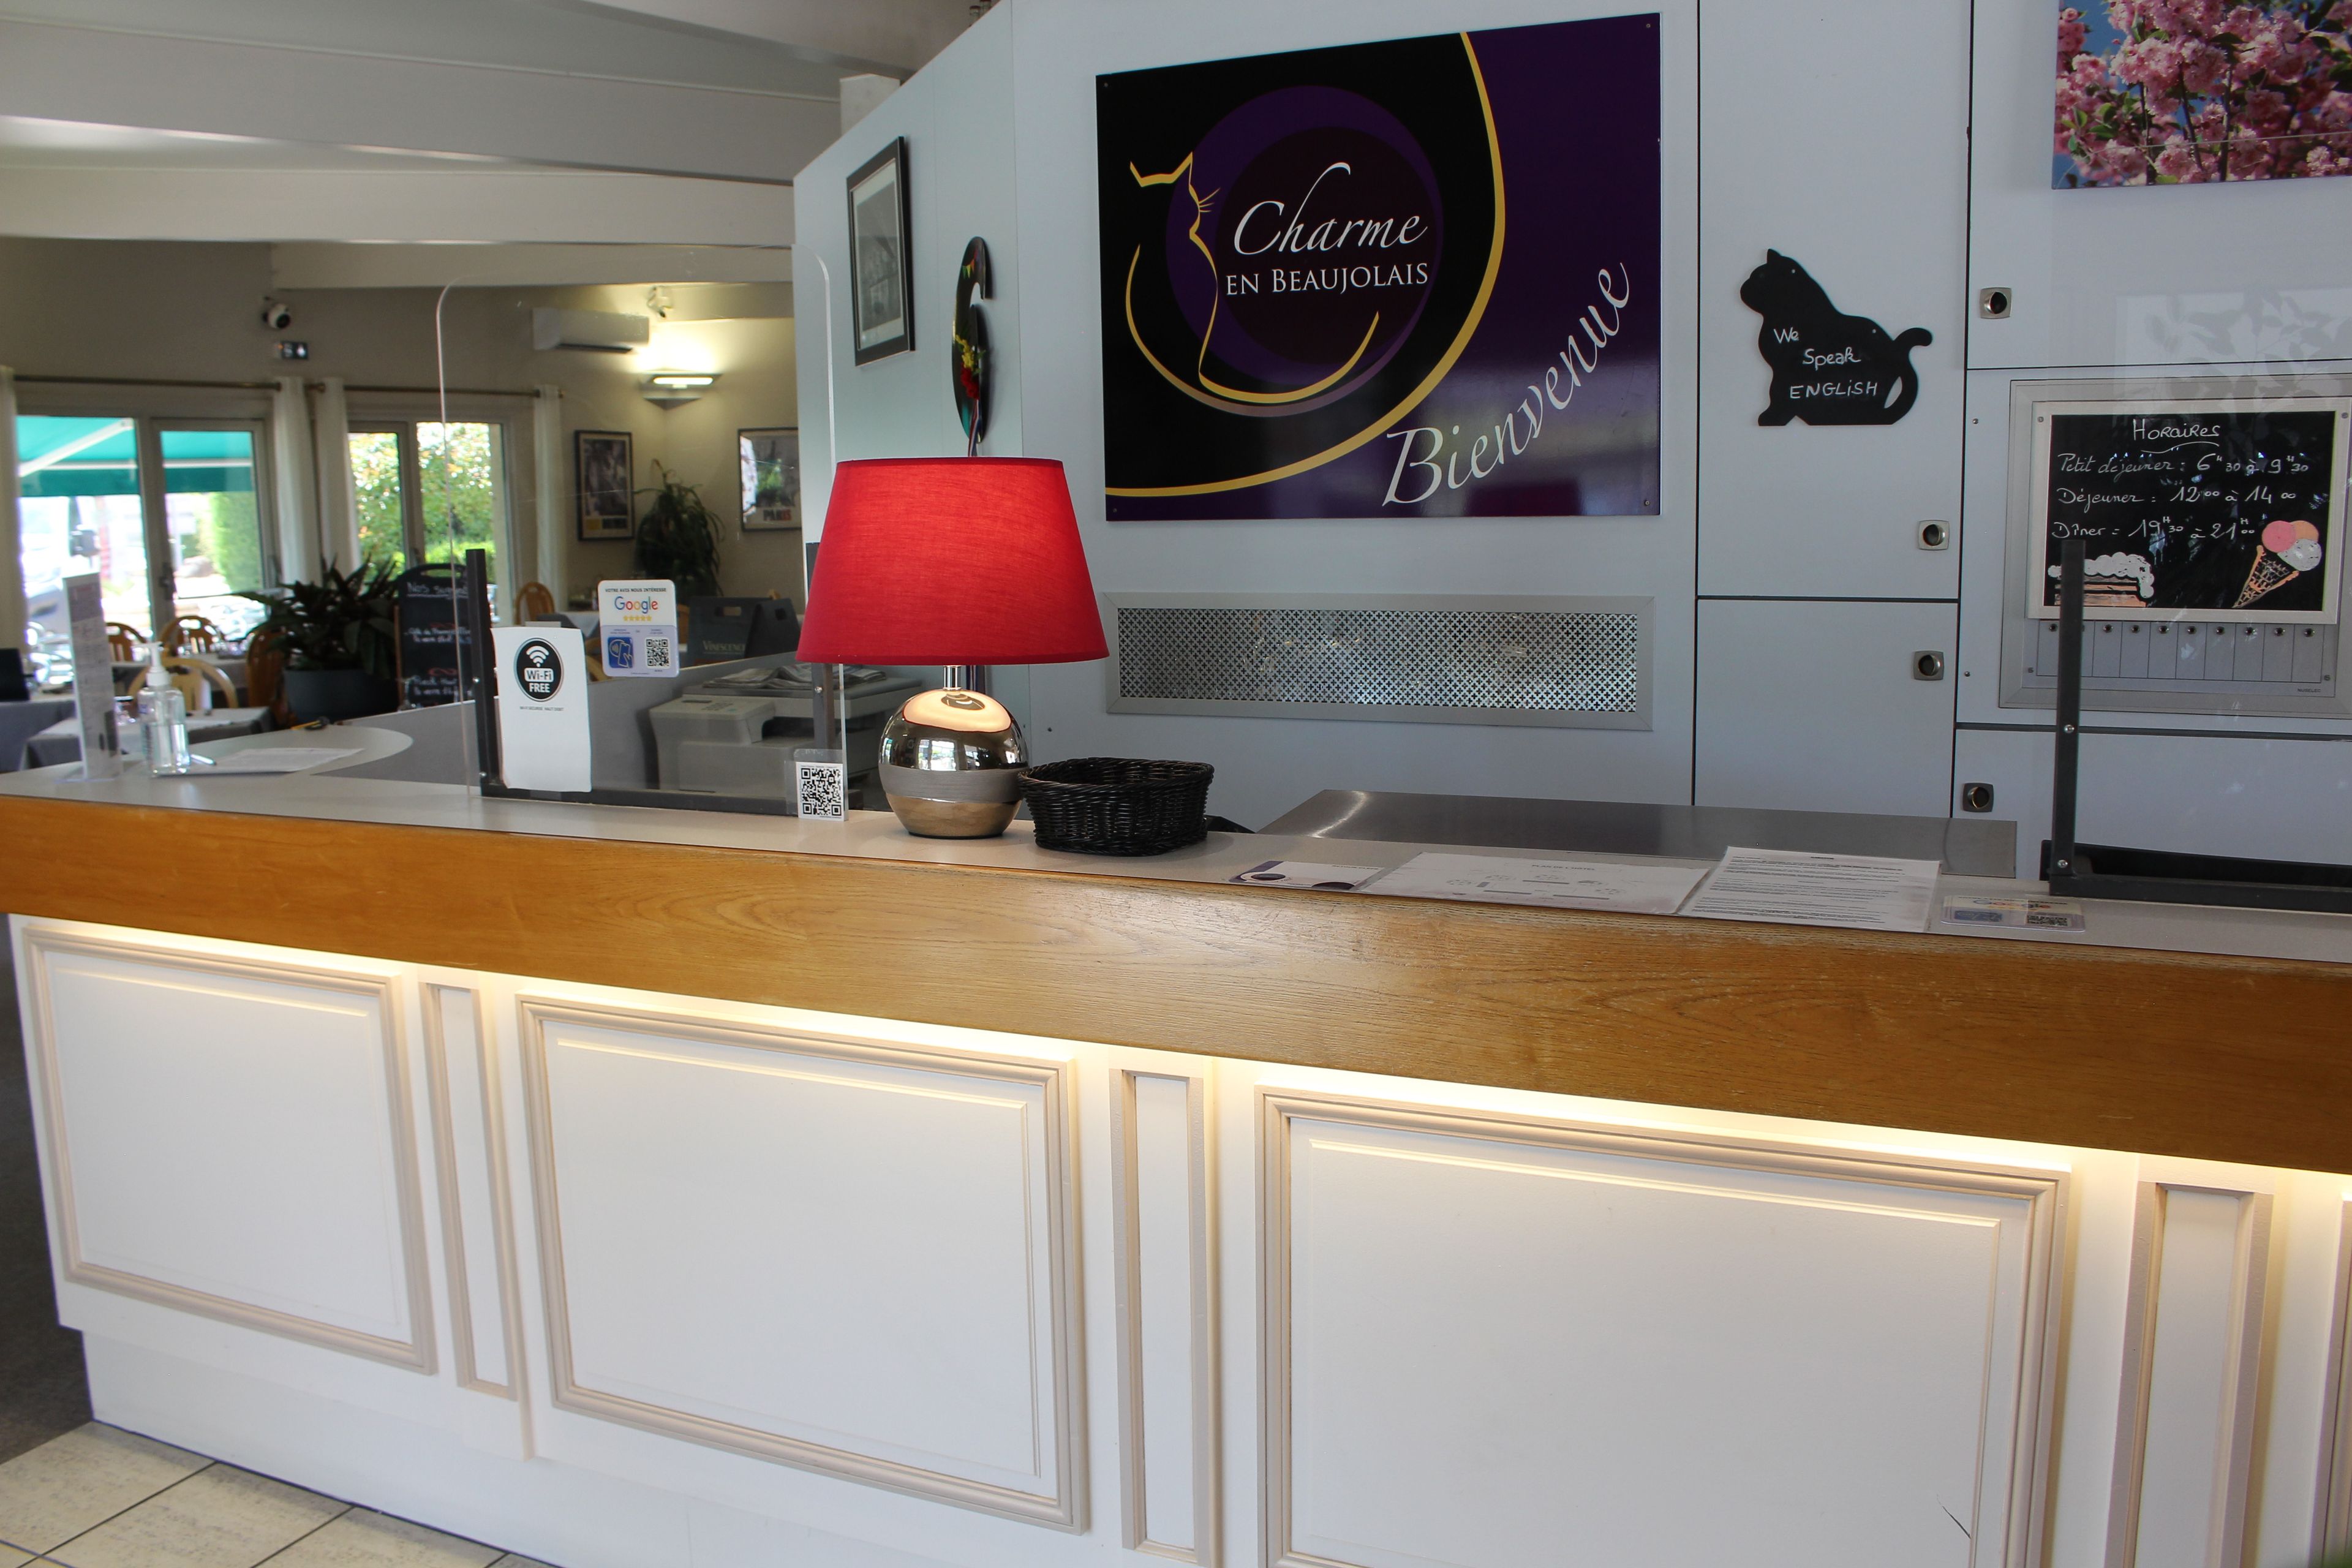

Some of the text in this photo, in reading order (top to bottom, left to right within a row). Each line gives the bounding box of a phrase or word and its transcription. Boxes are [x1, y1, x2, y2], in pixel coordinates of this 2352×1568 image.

[1234, 162, 1428, 255] Charme
[1226, 263, 1429, 295] EN BEAUJOLAIS
[1773, 326, 1800, 344] We
[1803, 347, 1861, 371] Speak
[1382, 262, 1630, 508] Bienvenue
[2057, 453, 2096, 472] Petit
[2056, 488, 2145, 514] Déjeuner
[2051, 521, 2106, 538] Dîner
[614, 596, 658, 614] Google
[527, 669, 552, 680] Wi-Fi
[529, 682, 551, 693] FREE
